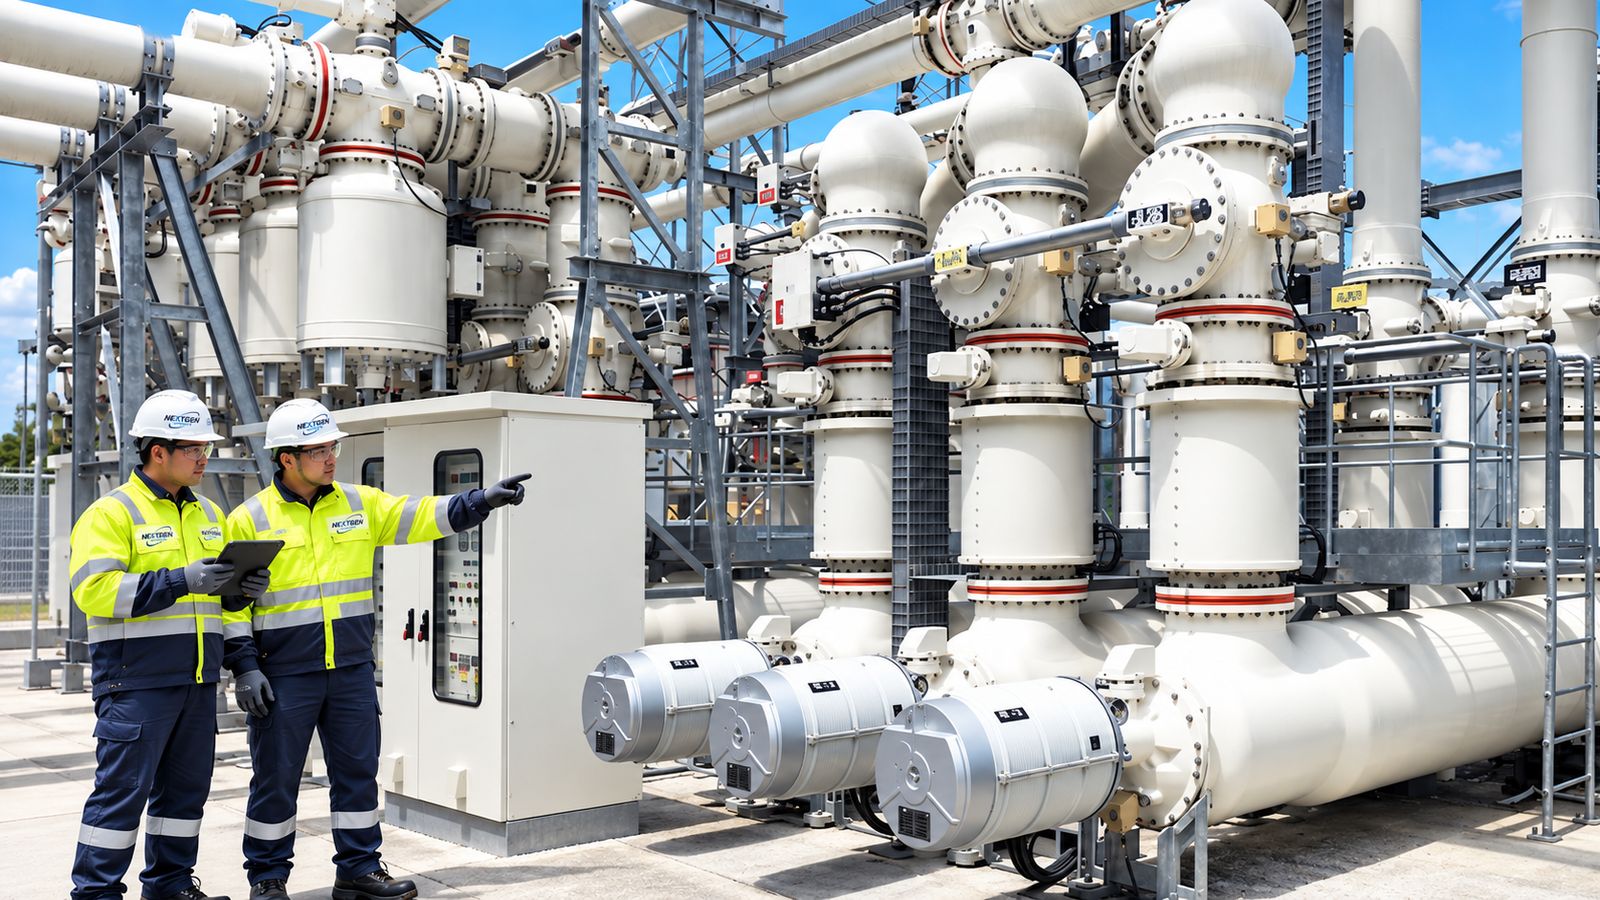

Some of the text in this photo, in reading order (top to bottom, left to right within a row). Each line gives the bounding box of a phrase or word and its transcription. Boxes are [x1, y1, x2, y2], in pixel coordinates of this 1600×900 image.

[163, 414, 201, 424] NEXTGEN
[296, 418, 330, 431] NEXTGEN
[331, 519, 364, 528] NEXTGEN
